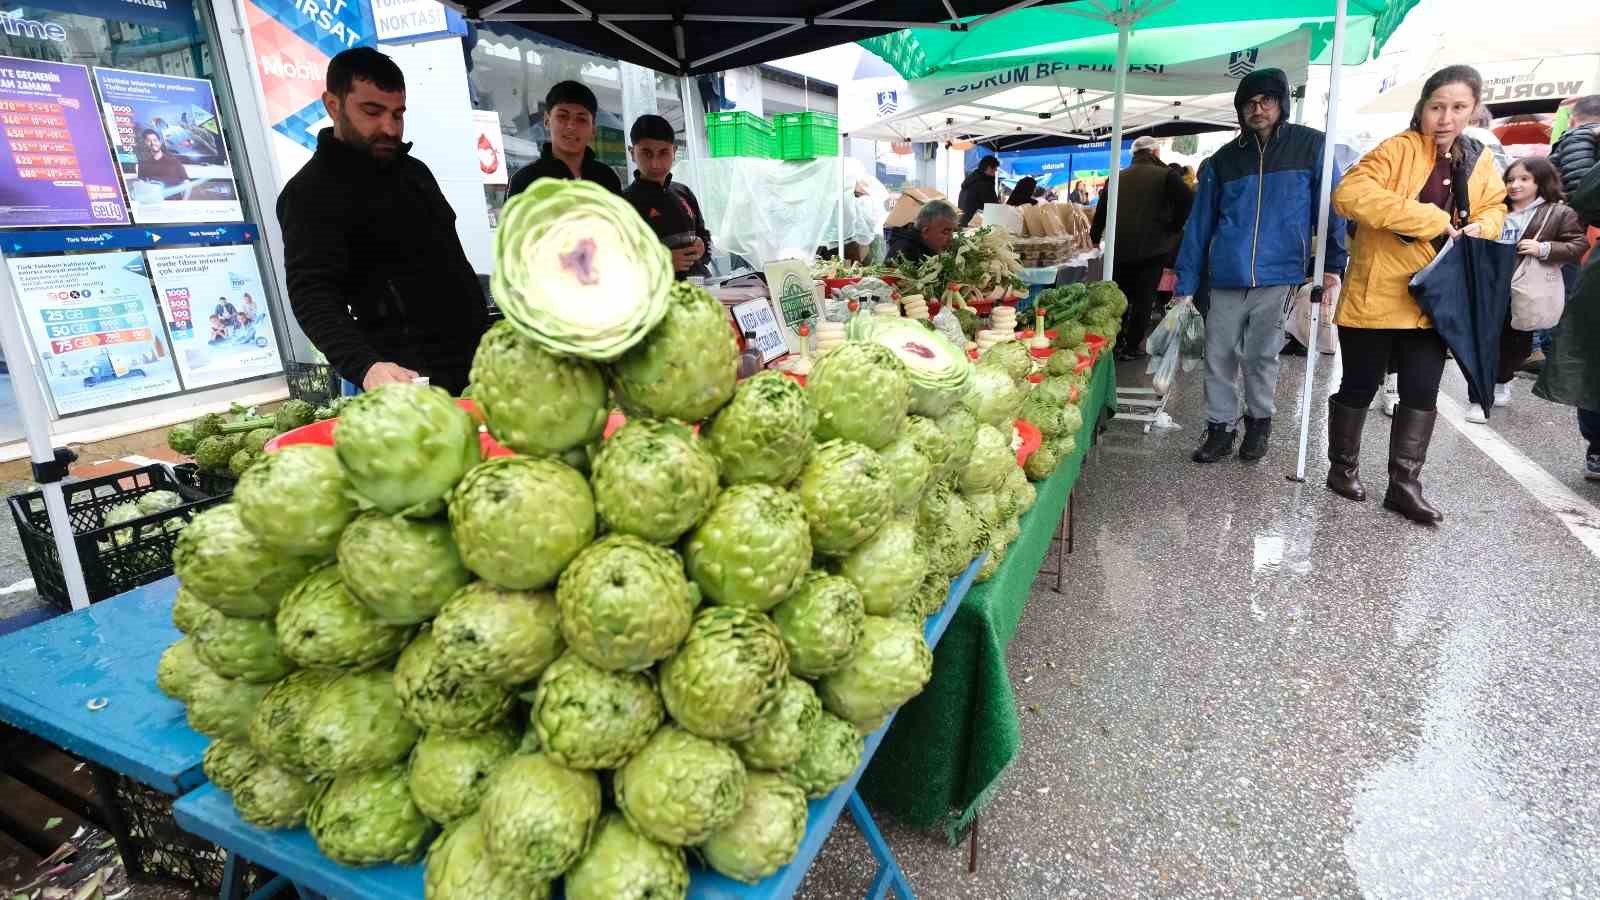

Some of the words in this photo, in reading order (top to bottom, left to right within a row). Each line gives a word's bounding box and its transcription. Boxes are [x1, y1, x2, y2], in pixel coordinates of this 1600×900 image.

[46, 310, 64, 320] 25
[64, 309, 84, 320] GB
[51, 325, 70, 336] 50
[55, 342, 73, 353] 75
